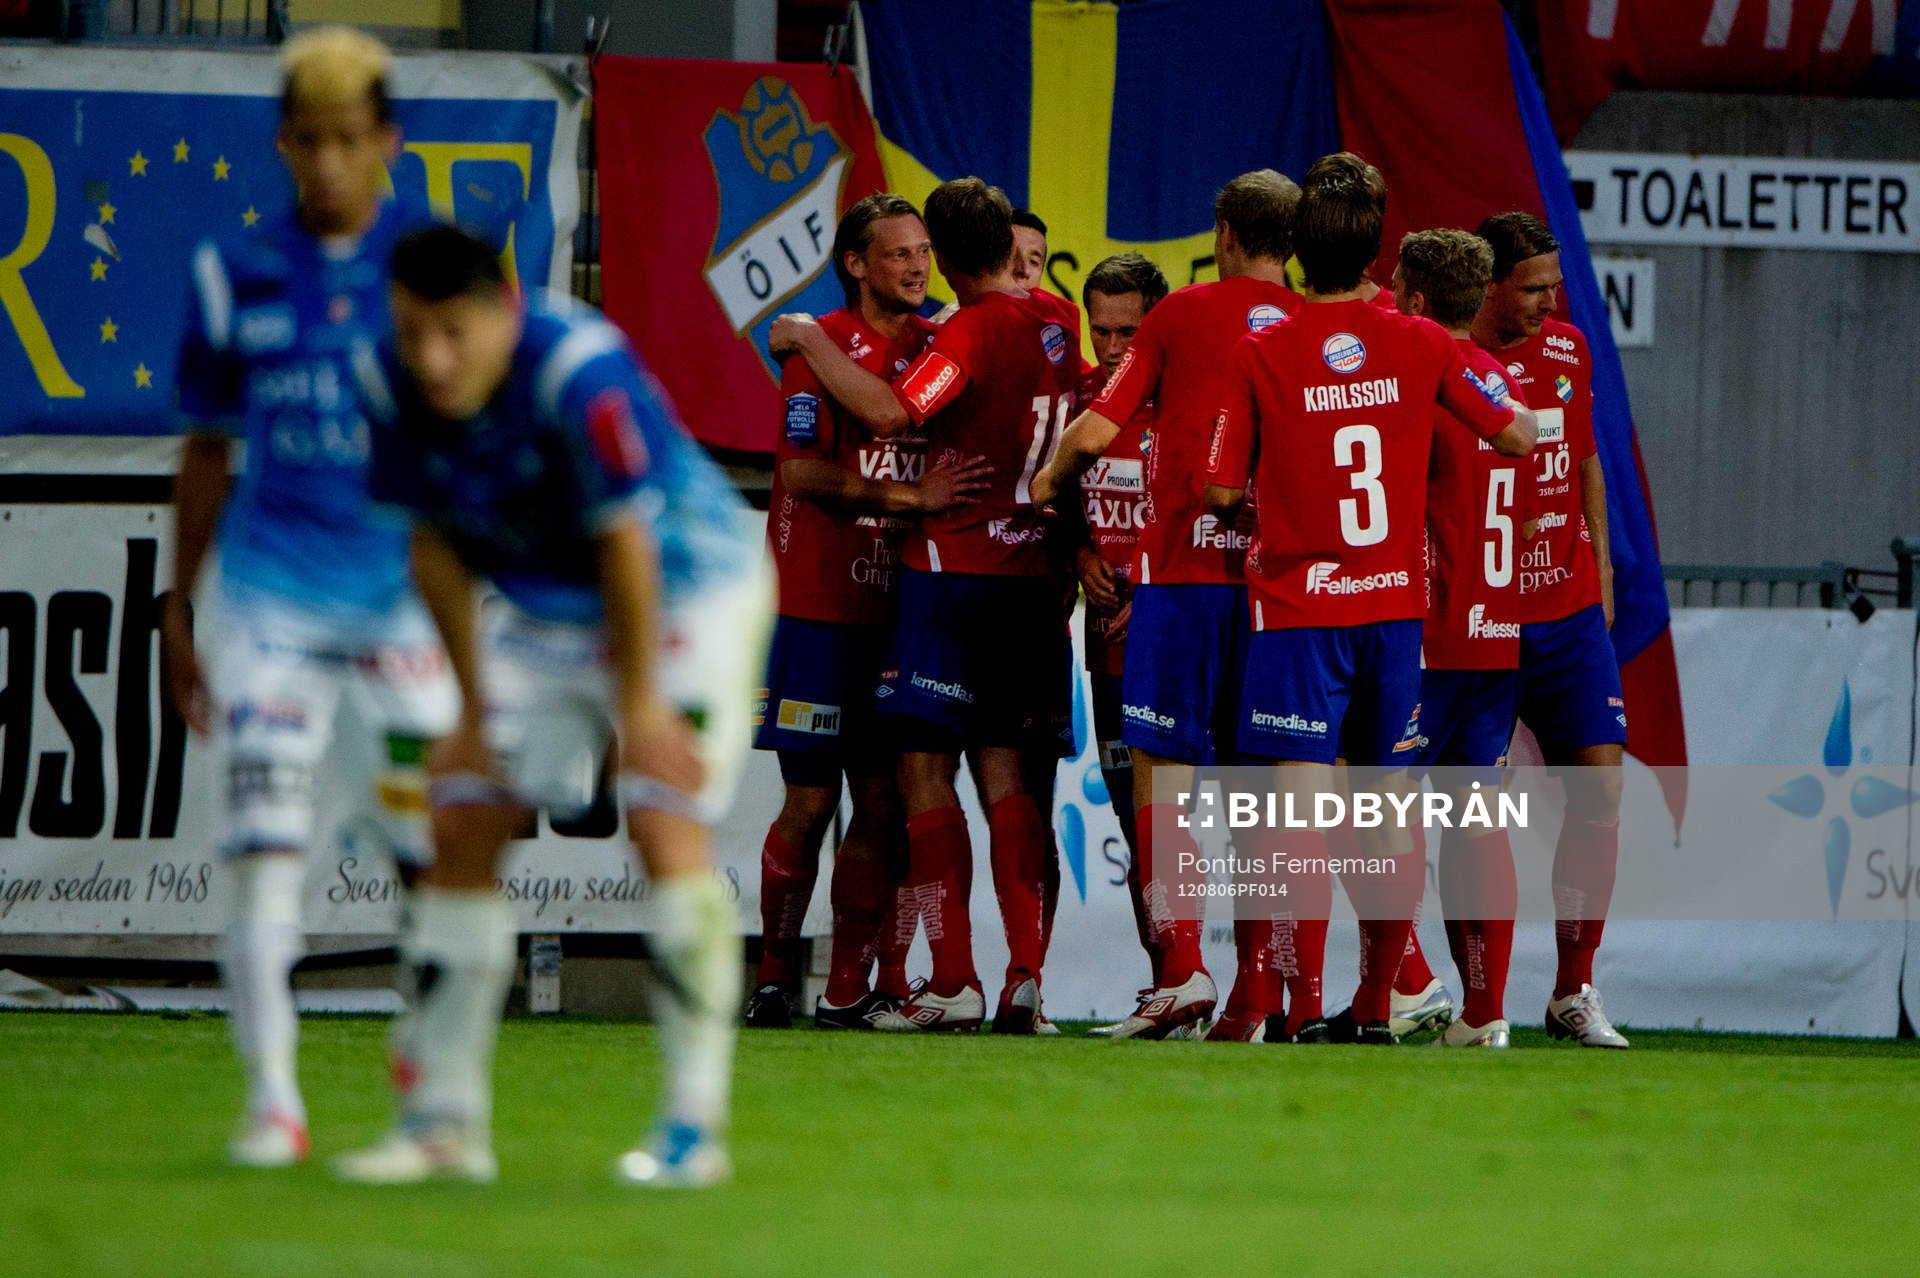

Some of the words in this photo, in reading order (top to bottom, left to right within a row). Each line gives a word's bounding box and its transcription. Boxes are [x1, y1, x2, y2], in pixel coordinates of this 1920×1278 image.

[1612, 169, 1907, 234] TOALETTER
[741, 210, 823, 300] ÖIF
[1546, 335, 1575, 351] elajo
[919, 364, 954, 406] Adecco
[1101, 352, 1133, 398] Adecco
[1303, 377, 1400, 413] KARLSSON
[1208, 414, 1226, 467] Adecco
[1107, 475, 1140, 488] PRODUKT
[1333, 424, 1389, 547] 3
[1484, 467, 1516, 589] 5
[1312, 568, 1410, 596] Fellesons
[49, 858, 137, 902] sedan
[146, 862, 213, 904] 1968
